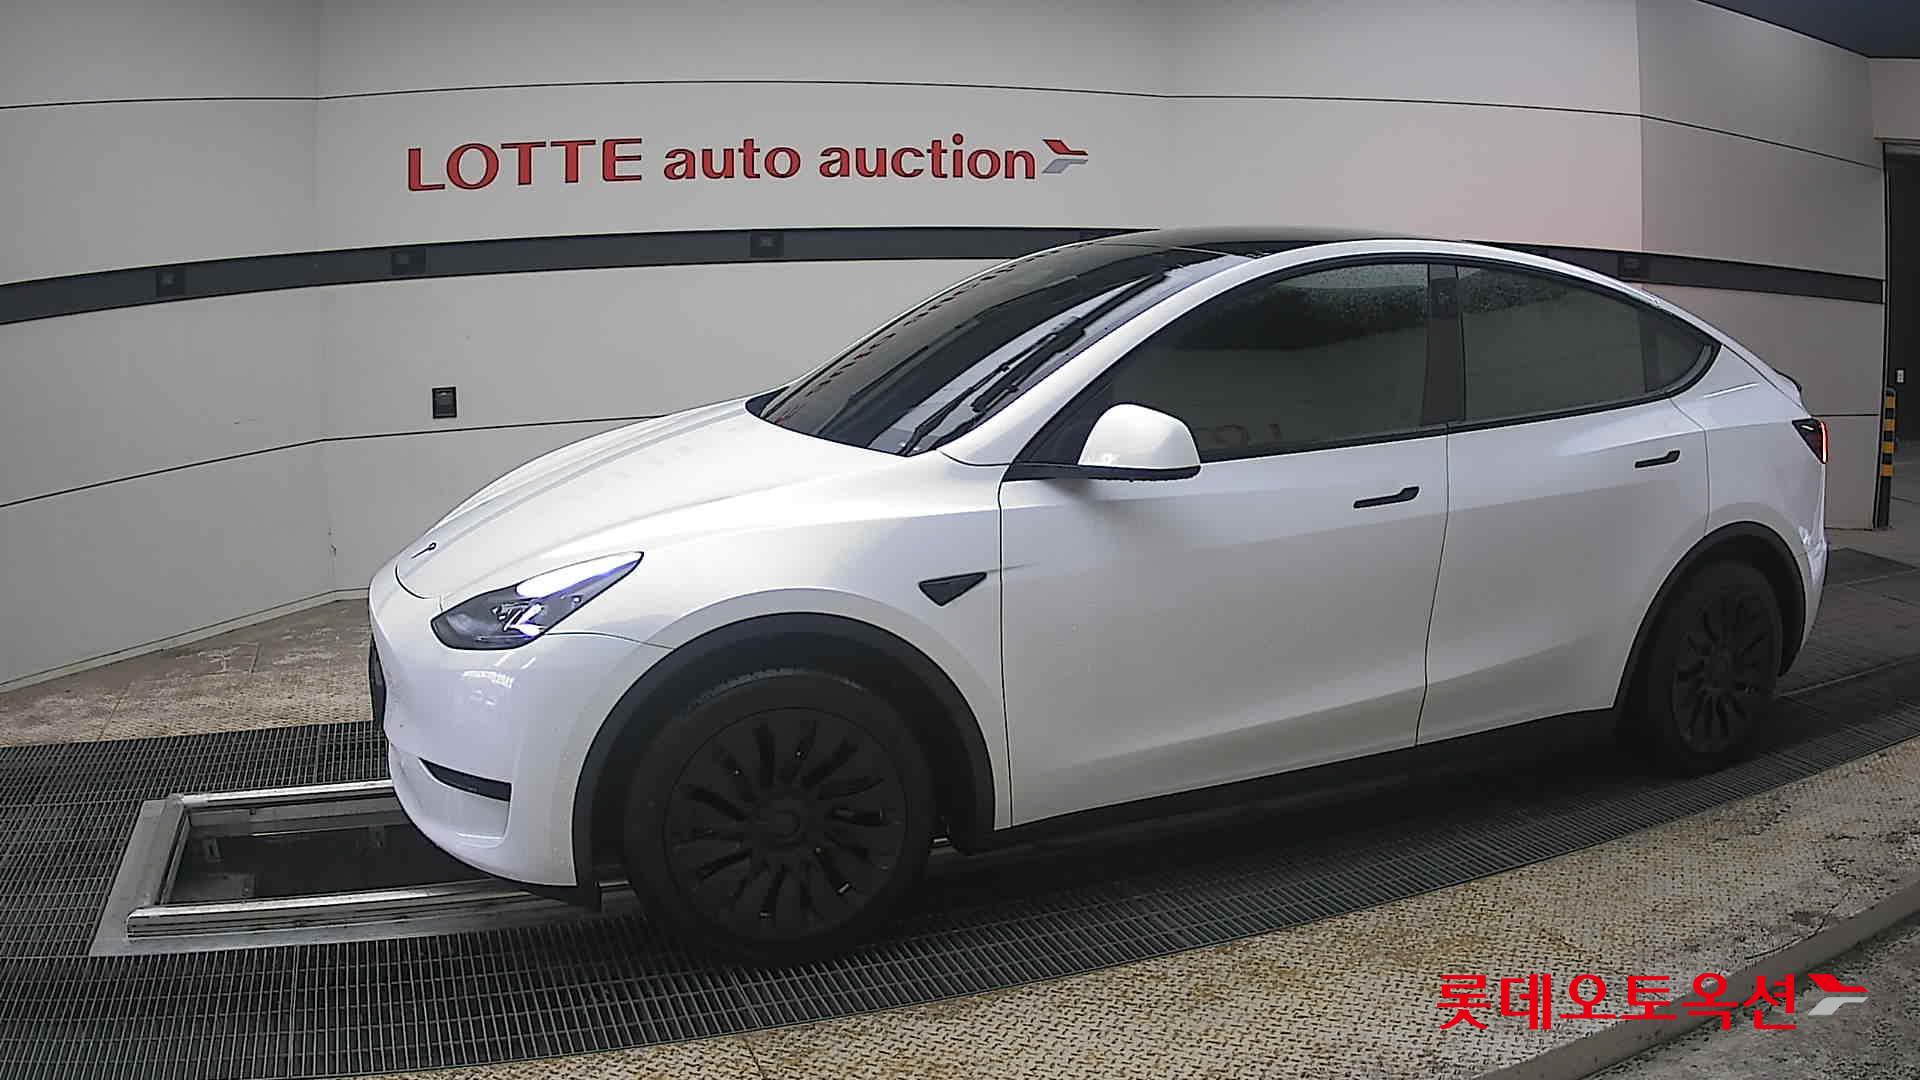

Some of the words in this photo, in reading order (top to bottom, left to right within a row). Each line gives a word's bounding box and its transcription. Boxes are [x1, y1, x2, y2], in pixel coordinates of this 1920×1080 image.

[407, 137, 643, 193] LOTTE
[663, 138, 802, 181] auto
[818, 133, 1038, 180] auction
